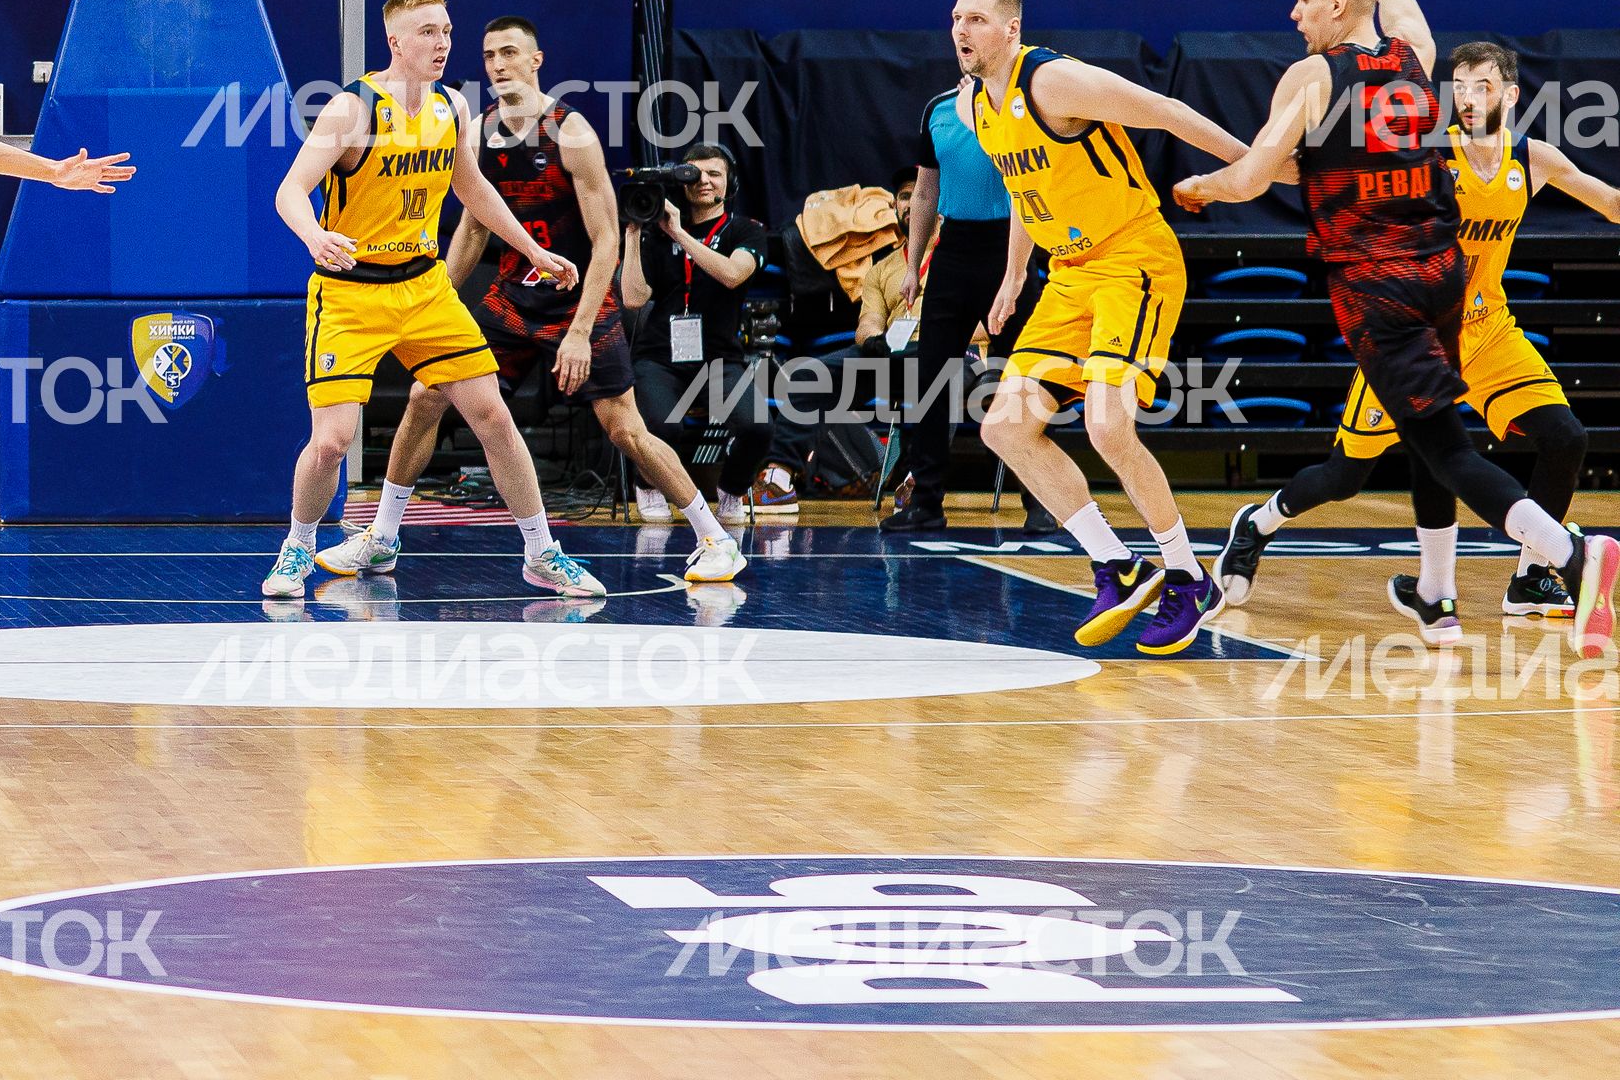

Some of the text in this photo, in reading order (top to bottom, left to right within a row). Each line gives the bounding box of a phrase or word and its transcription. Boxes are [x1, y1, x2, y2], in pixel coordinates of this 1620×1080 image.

[1360, 85, 1421, 153] 21
[377, 147, 455, 178] ХИМКИ
[399, 188, 427, 220] 10
[149, 324, 195, 336] ХИМКИ
